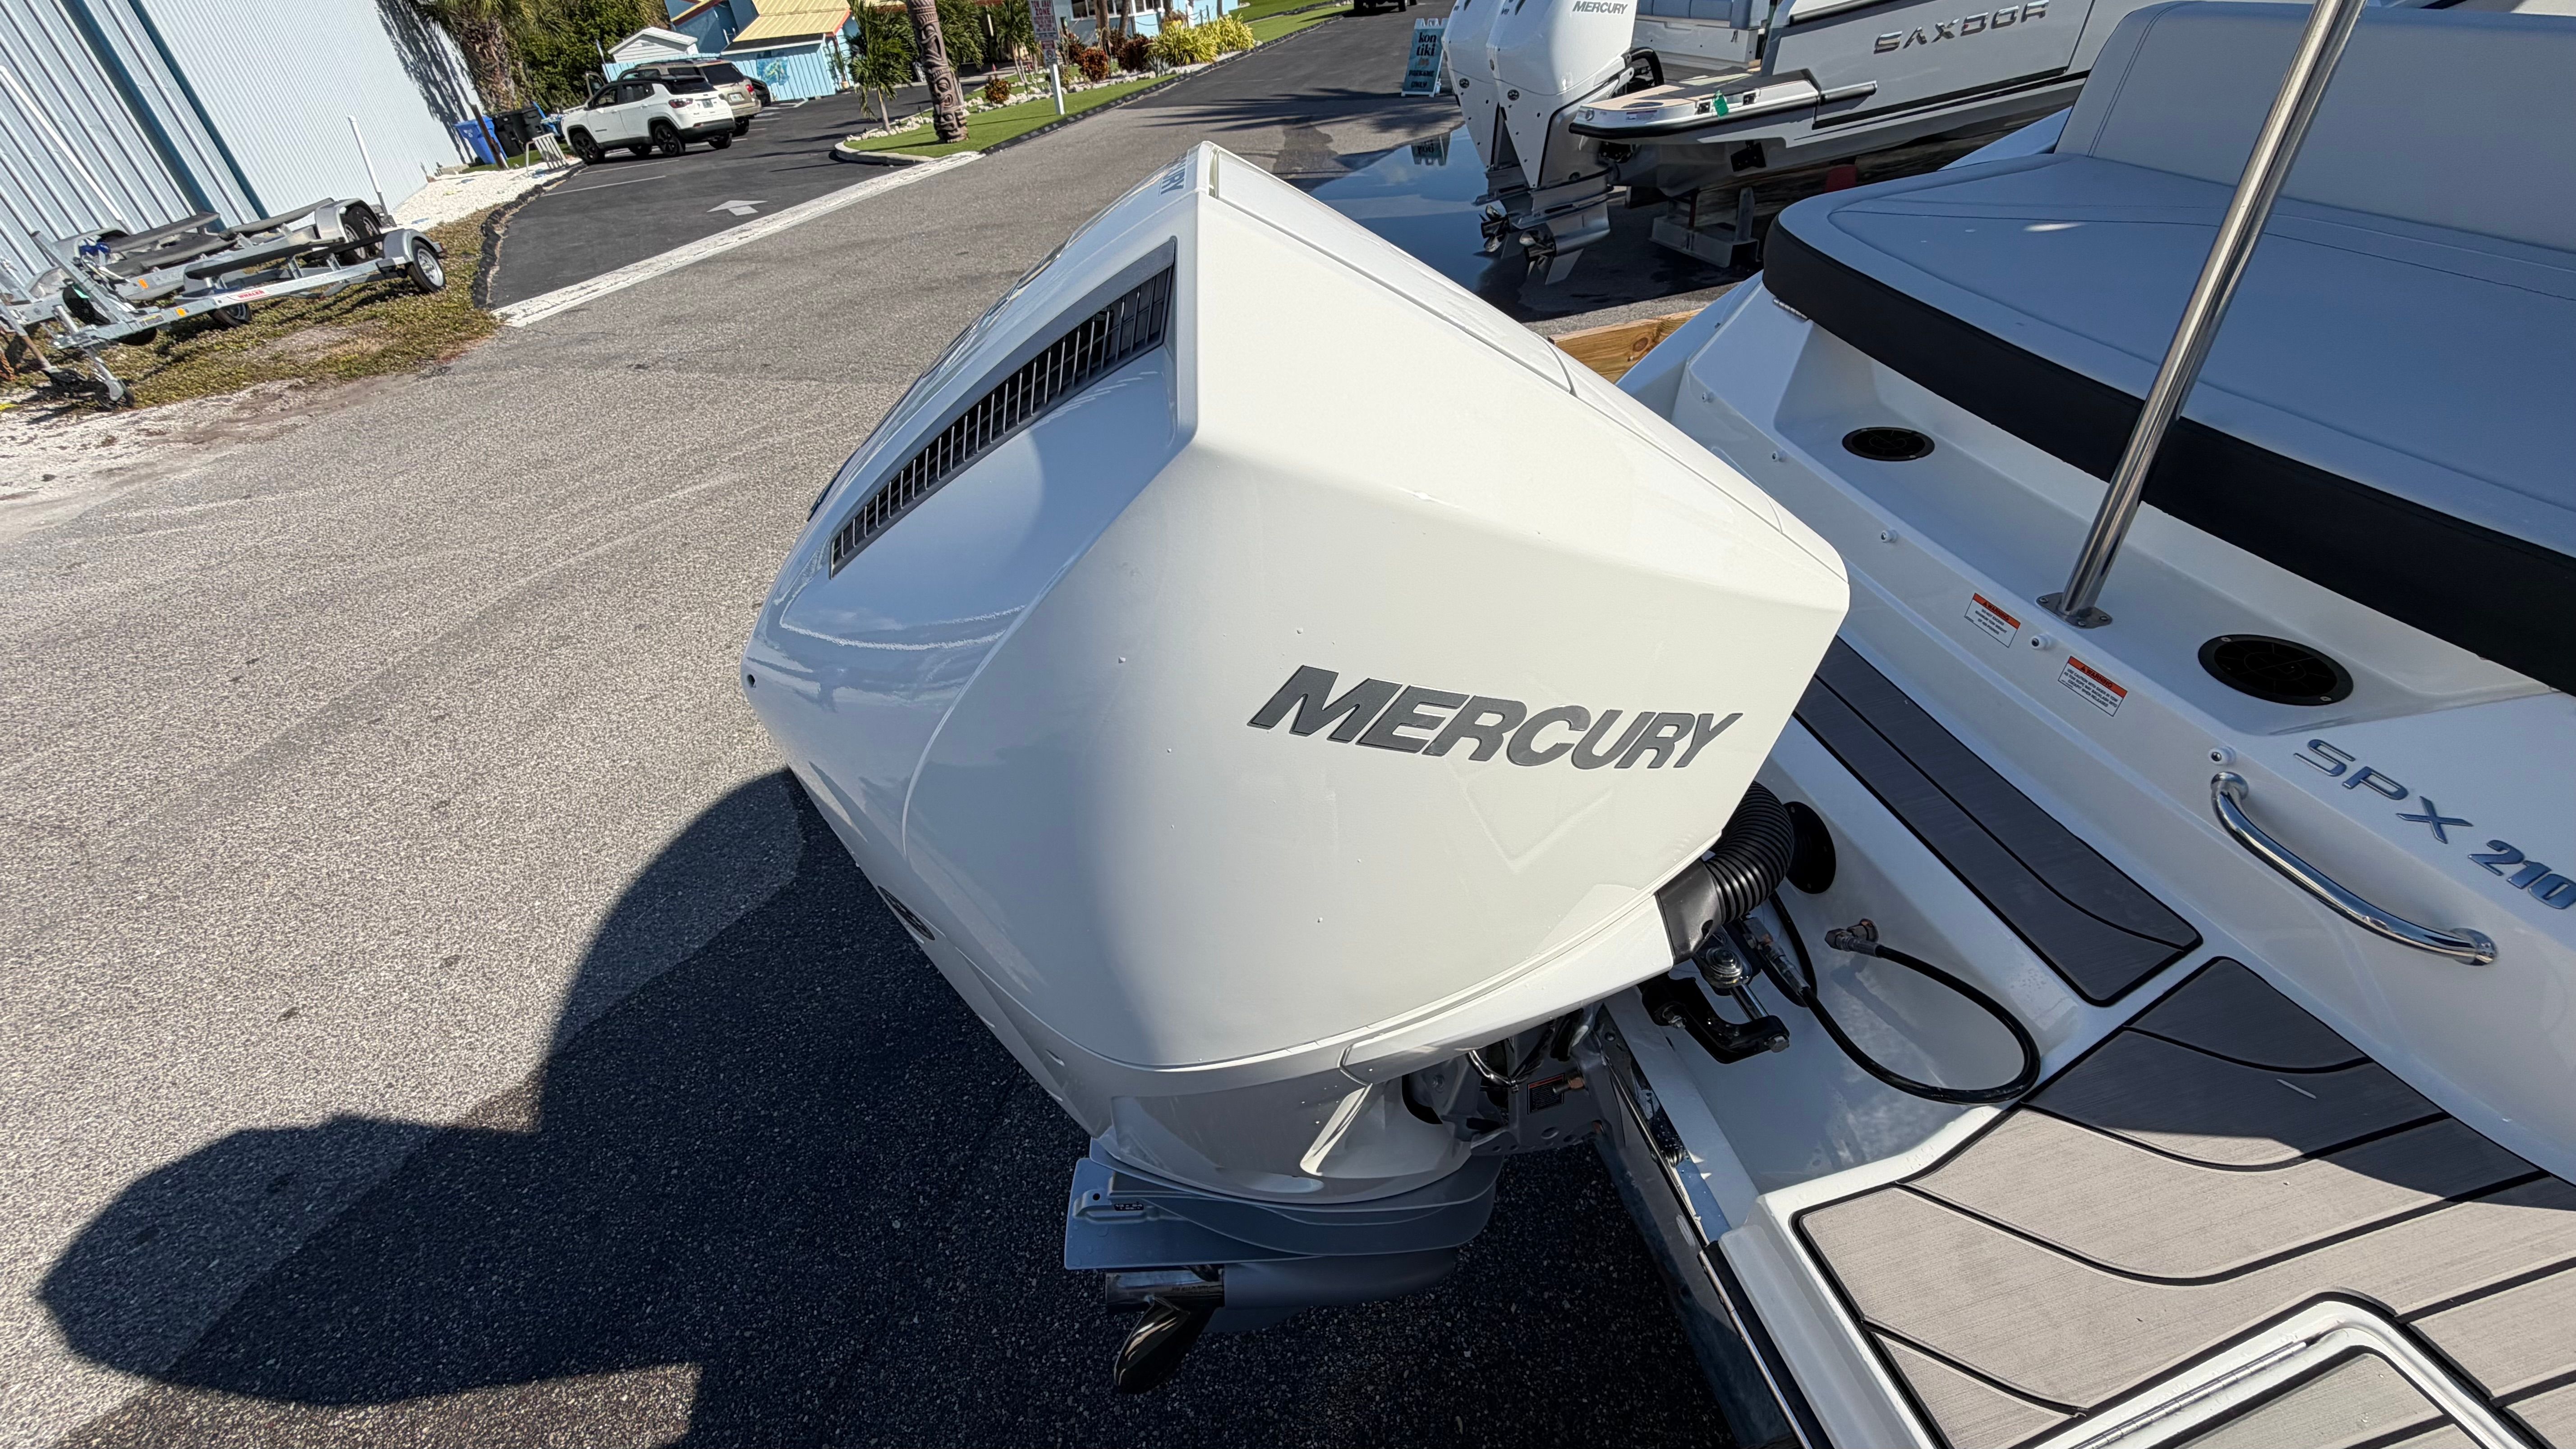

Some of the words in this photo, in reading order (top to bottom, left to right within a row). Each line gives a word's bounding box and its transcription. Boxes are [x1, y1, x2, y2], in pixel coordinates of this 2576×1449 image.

[1573, 1, 1628, 14] MERCURY
[1873, 0, 2050, 54] SAXDOR
[1418, 32, 1437, 43] kon
[1416, 43, 1435, 56] tiki
[238, 290, 265, 299] WHALER
[1987, 604, 2010, 621] WARNING
[2074, 672, 2088, 683] CAUTION
[2086, 668, 2113, 689] WARNING
[1247, 664, 1744, 770] MERCURY
[2293, 739, 2474, 844] SPX
[2468, 839, 2576, 910] 210
